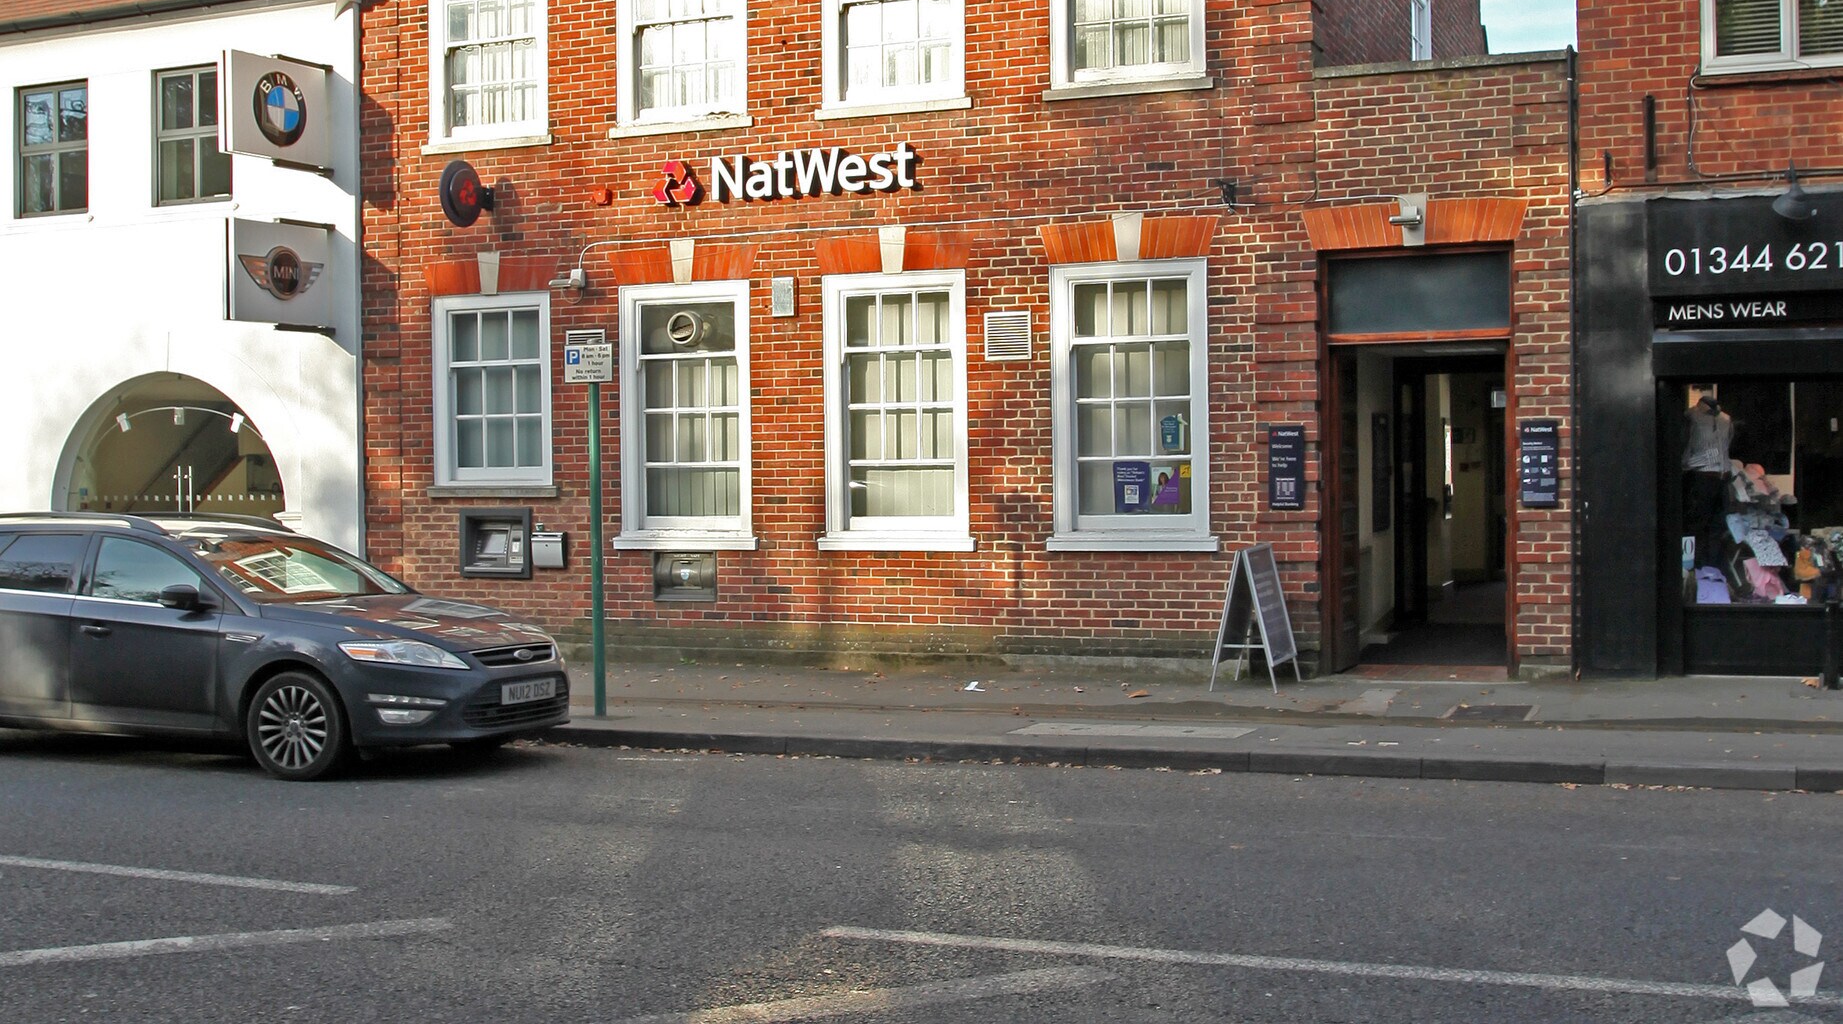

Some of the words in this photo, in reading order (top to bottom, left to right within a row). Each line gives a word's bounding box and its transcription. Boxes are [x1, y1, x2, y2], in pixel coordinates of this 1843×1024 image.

[711, 141, 913, 201] NatWest
[1665, 243, 1773, 276] 01344
[1785, 240, 1843, 271] 621
[1668, 303, 1724, 321] MENS
[1730, 301, 1787, 318] WEAR
[569, 351, 578, 363] P
